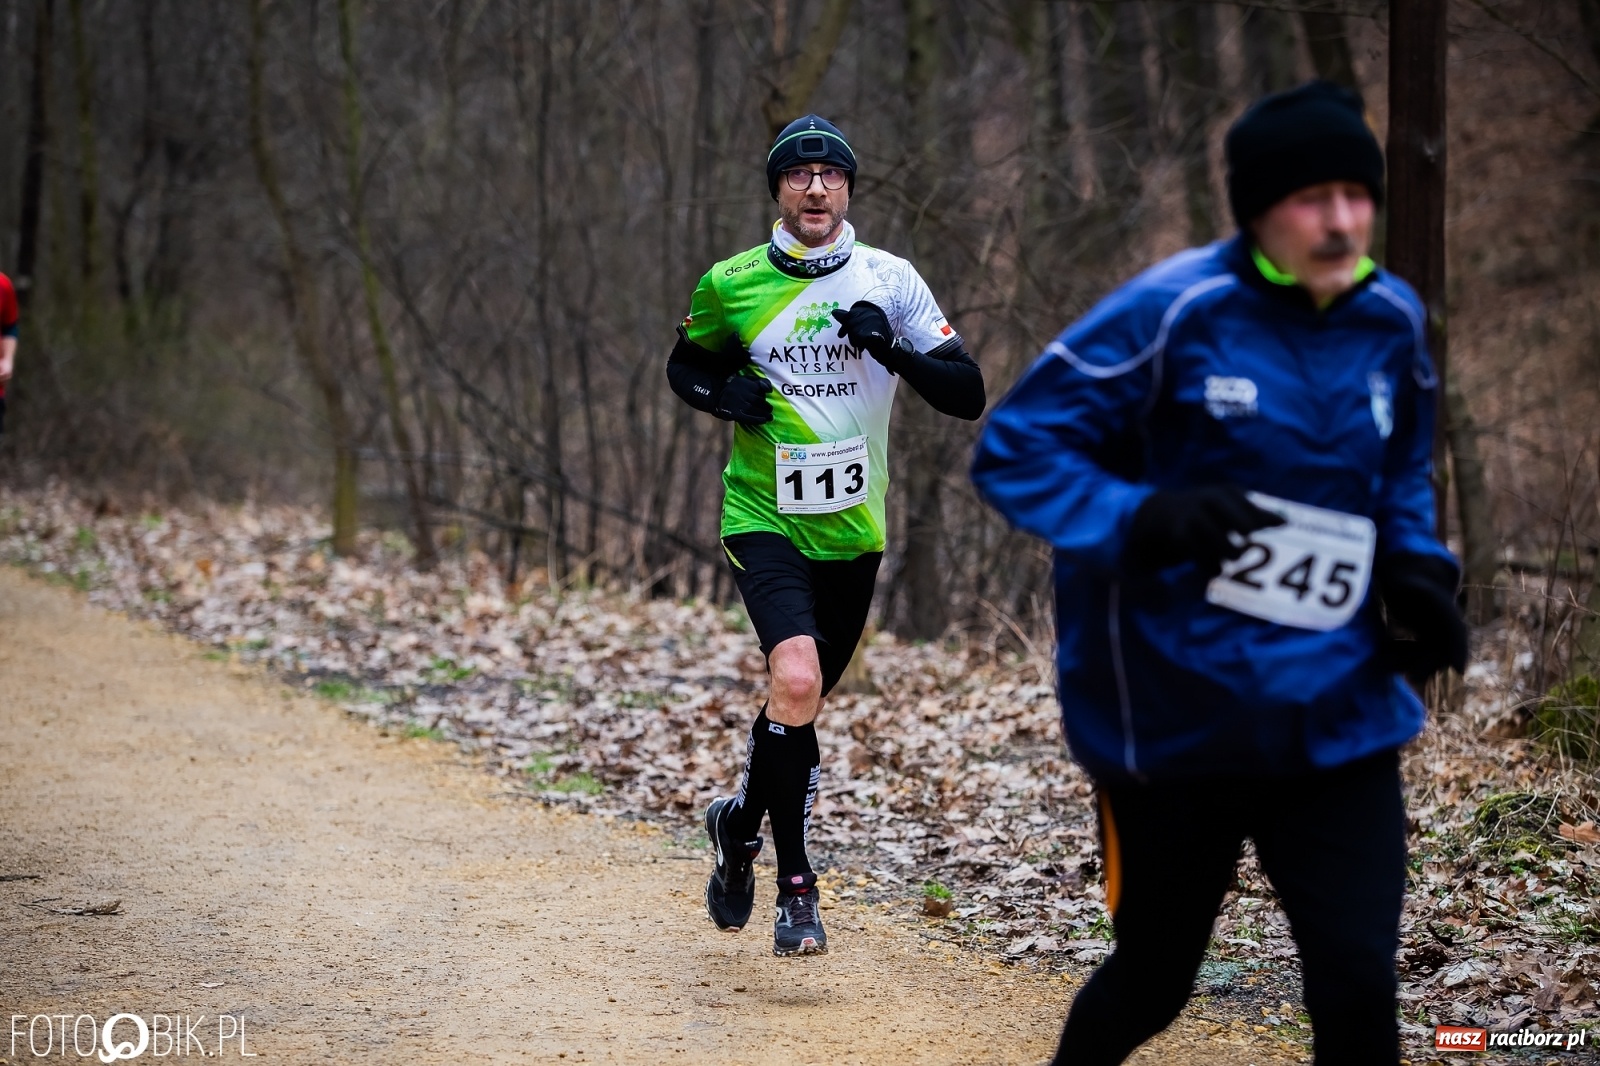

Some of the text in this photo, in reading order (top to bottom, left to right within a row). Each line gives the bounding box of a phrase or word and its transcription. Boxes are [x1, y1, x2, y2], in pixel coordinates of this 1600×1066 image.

[790, 361, 845, 373] LYSKI
[781, 382, 858, 397] GEOFART
[810, 443, 866, 457] www.personalbest.pl
[784, 462, 864, 501] 113
[1230, 542, 1357, 608] 245
